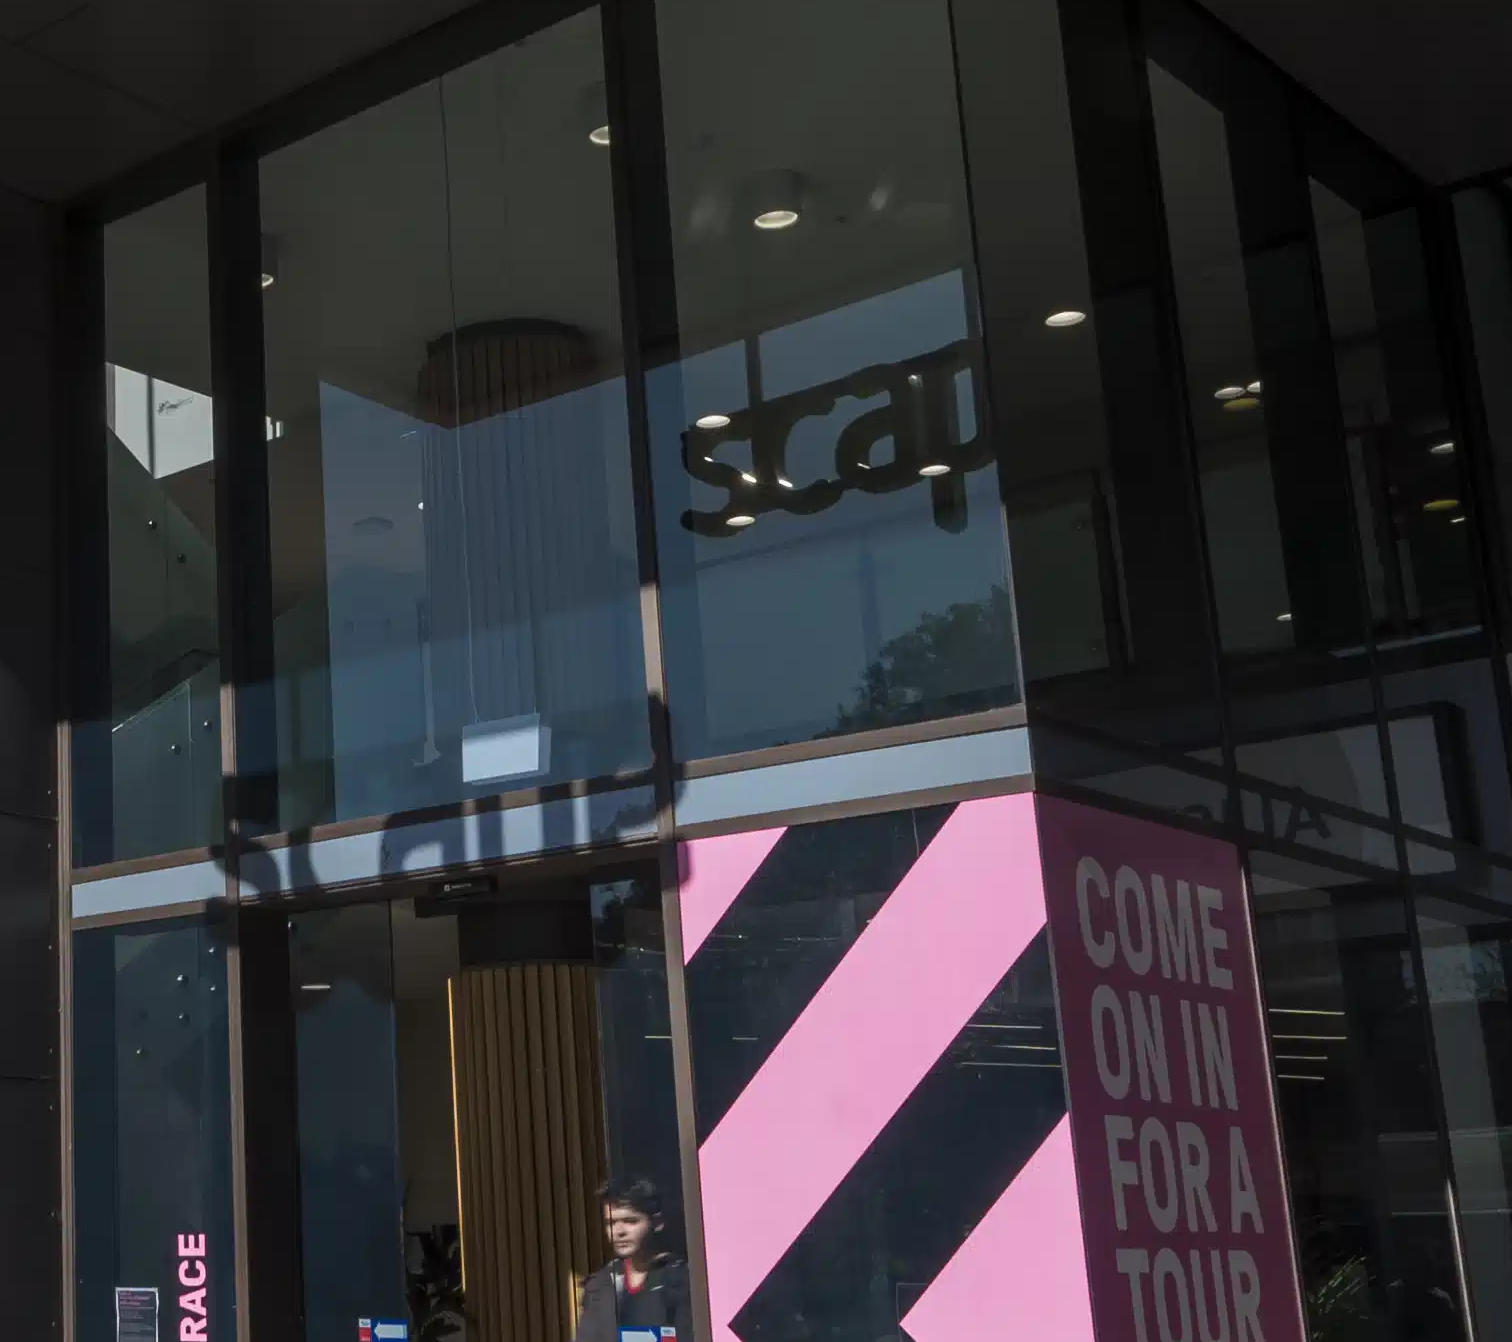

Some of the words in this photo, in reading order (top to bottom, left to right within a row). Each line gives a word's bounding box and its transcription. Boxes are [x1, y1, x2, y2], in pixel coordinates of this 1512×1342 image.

[1075, 855, 1234, 990] COME
[1090, 984, 1173, 1104] ON
[1179, 999, 1238, 1111] IN
[1103, 1113, 1219, 1234] FOR
[1228, 1126, 1265, 1234] A
